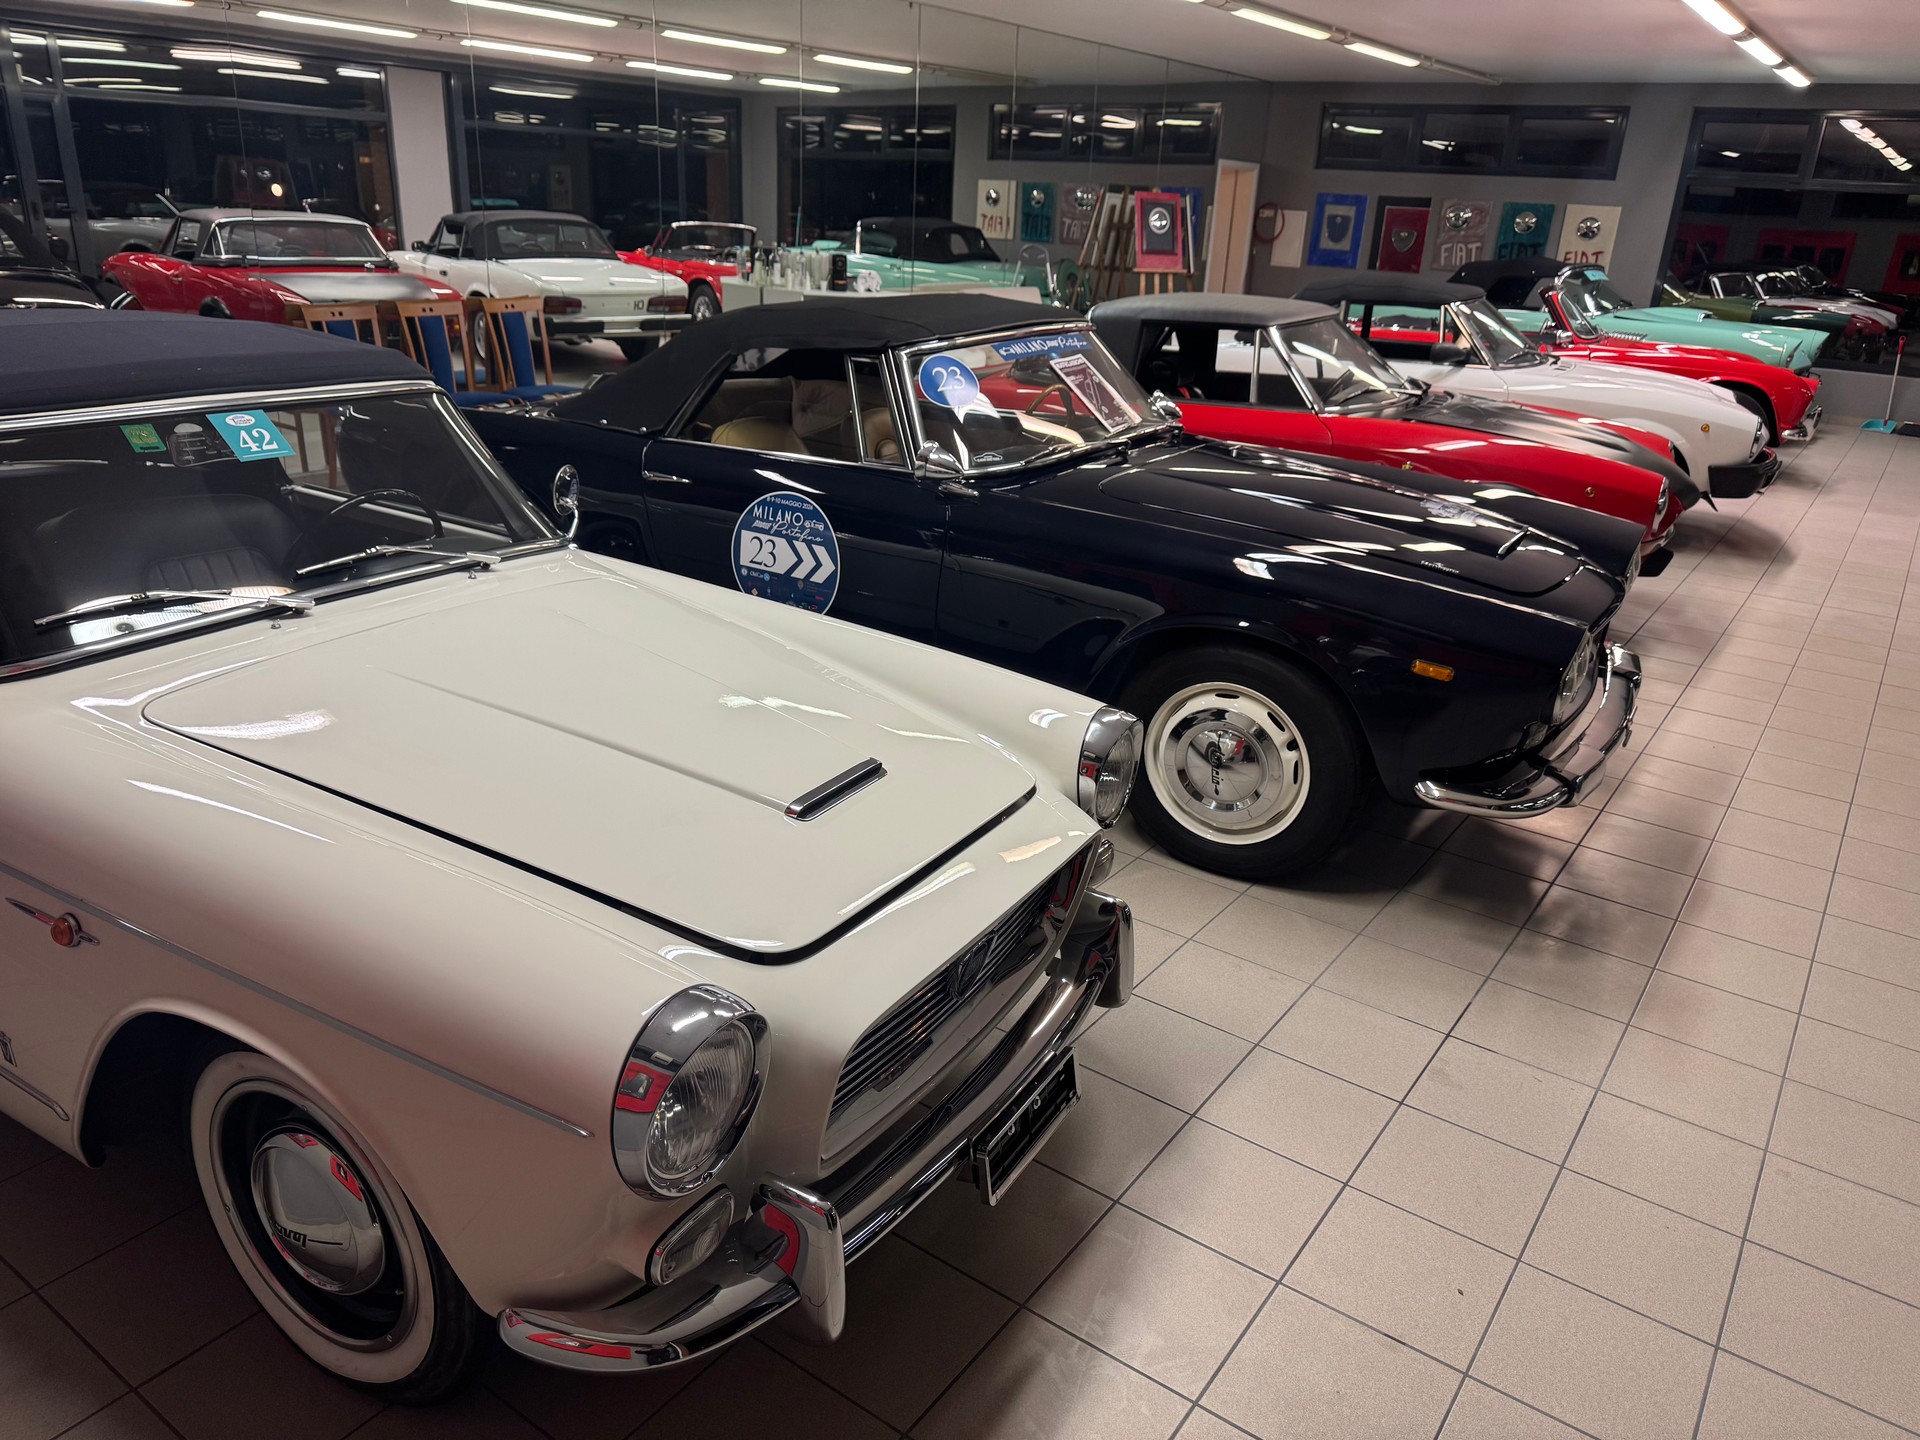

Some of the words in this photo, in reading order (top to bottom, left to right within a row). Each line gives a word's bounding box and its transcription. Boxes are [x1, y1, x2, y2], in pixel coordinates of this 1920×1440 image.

[1440, 243, 1483, 267] FIAT
[1011, 339, 1048, 355] MILANO
[932, 366, 966, 392] 23
[239, 428, 279, 452] 42
[752, 504, 804, 526] MILANO
[781, 499, 802, 509] MAGGIO
[770, 520, 824, 542] Portofino
[749, 536, 777, 568] 23
